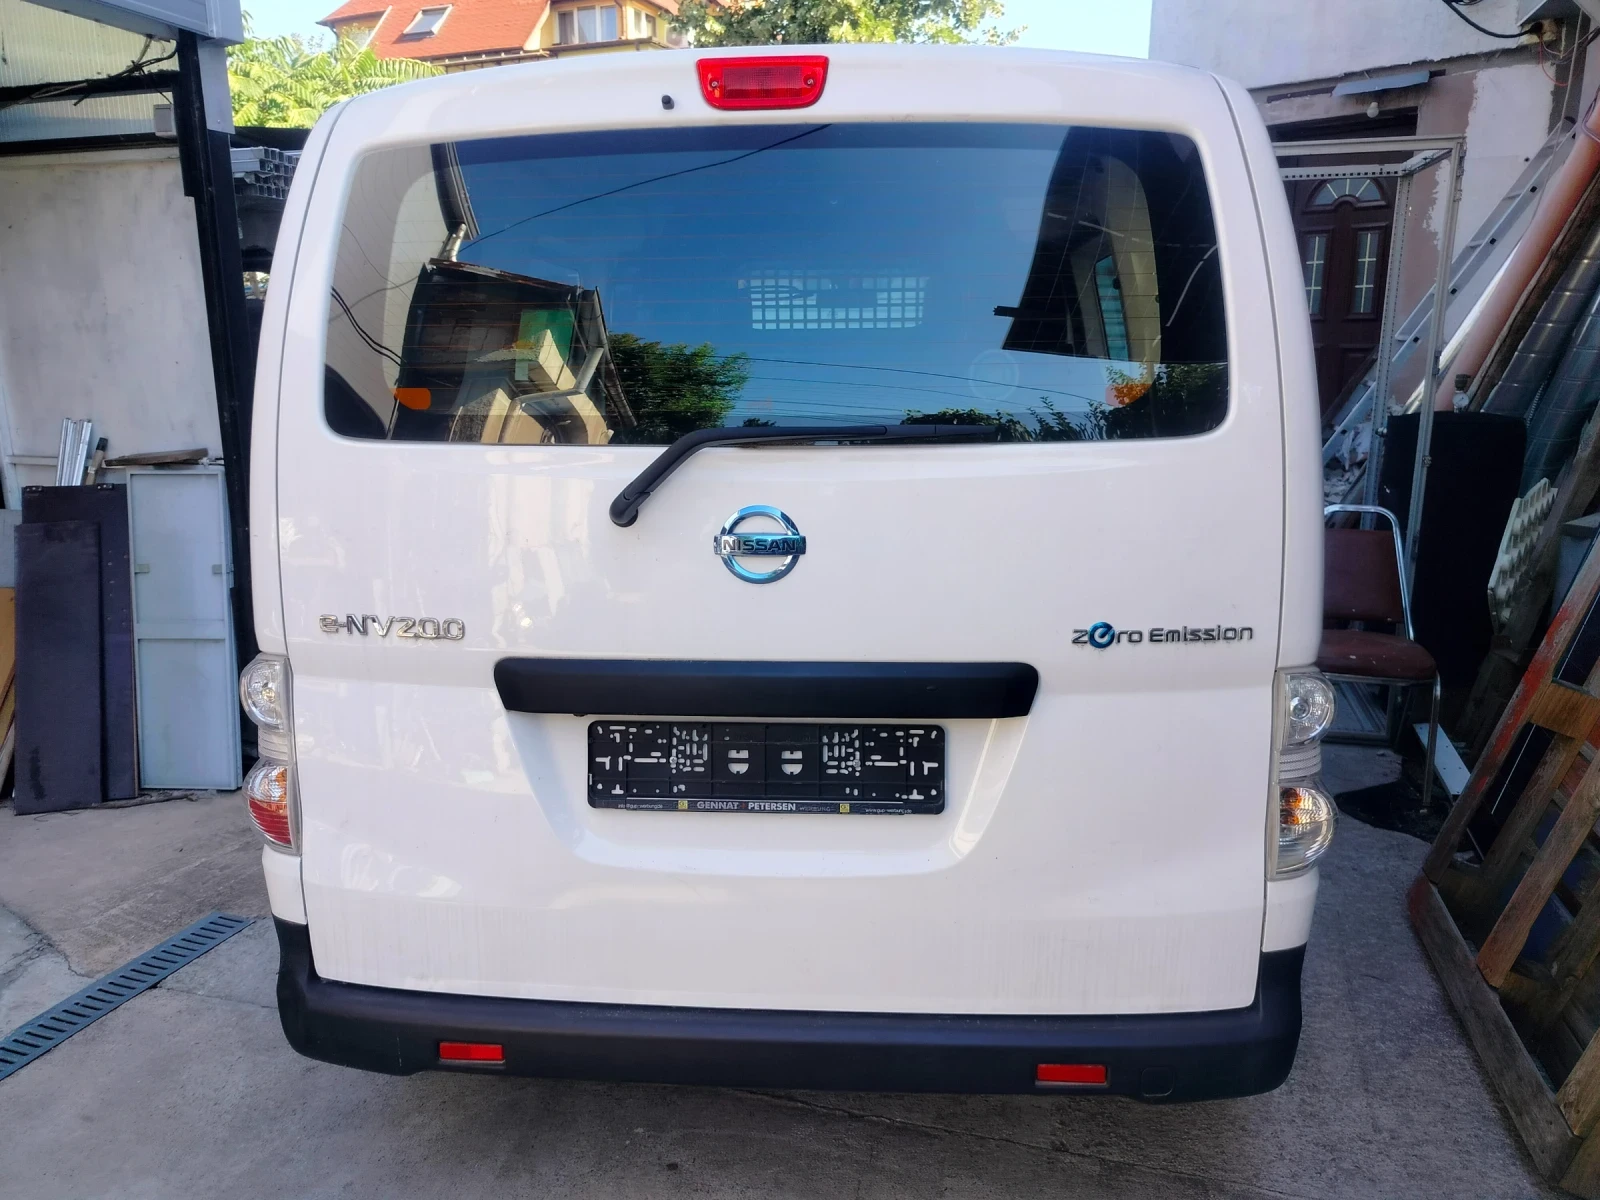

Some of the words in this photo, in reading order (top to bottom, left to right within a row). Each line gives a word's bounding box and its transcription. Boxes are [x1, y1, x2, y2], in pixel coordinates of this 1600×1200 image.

[722, 538, 796, 551] NISSAN
[319, 613, 466, 640] e-NV200
[1148, 625, 1254, 644] Emission
[696, 801, 739, 810] GENNAT
[748, 802, 796, 811] PETERSEN
